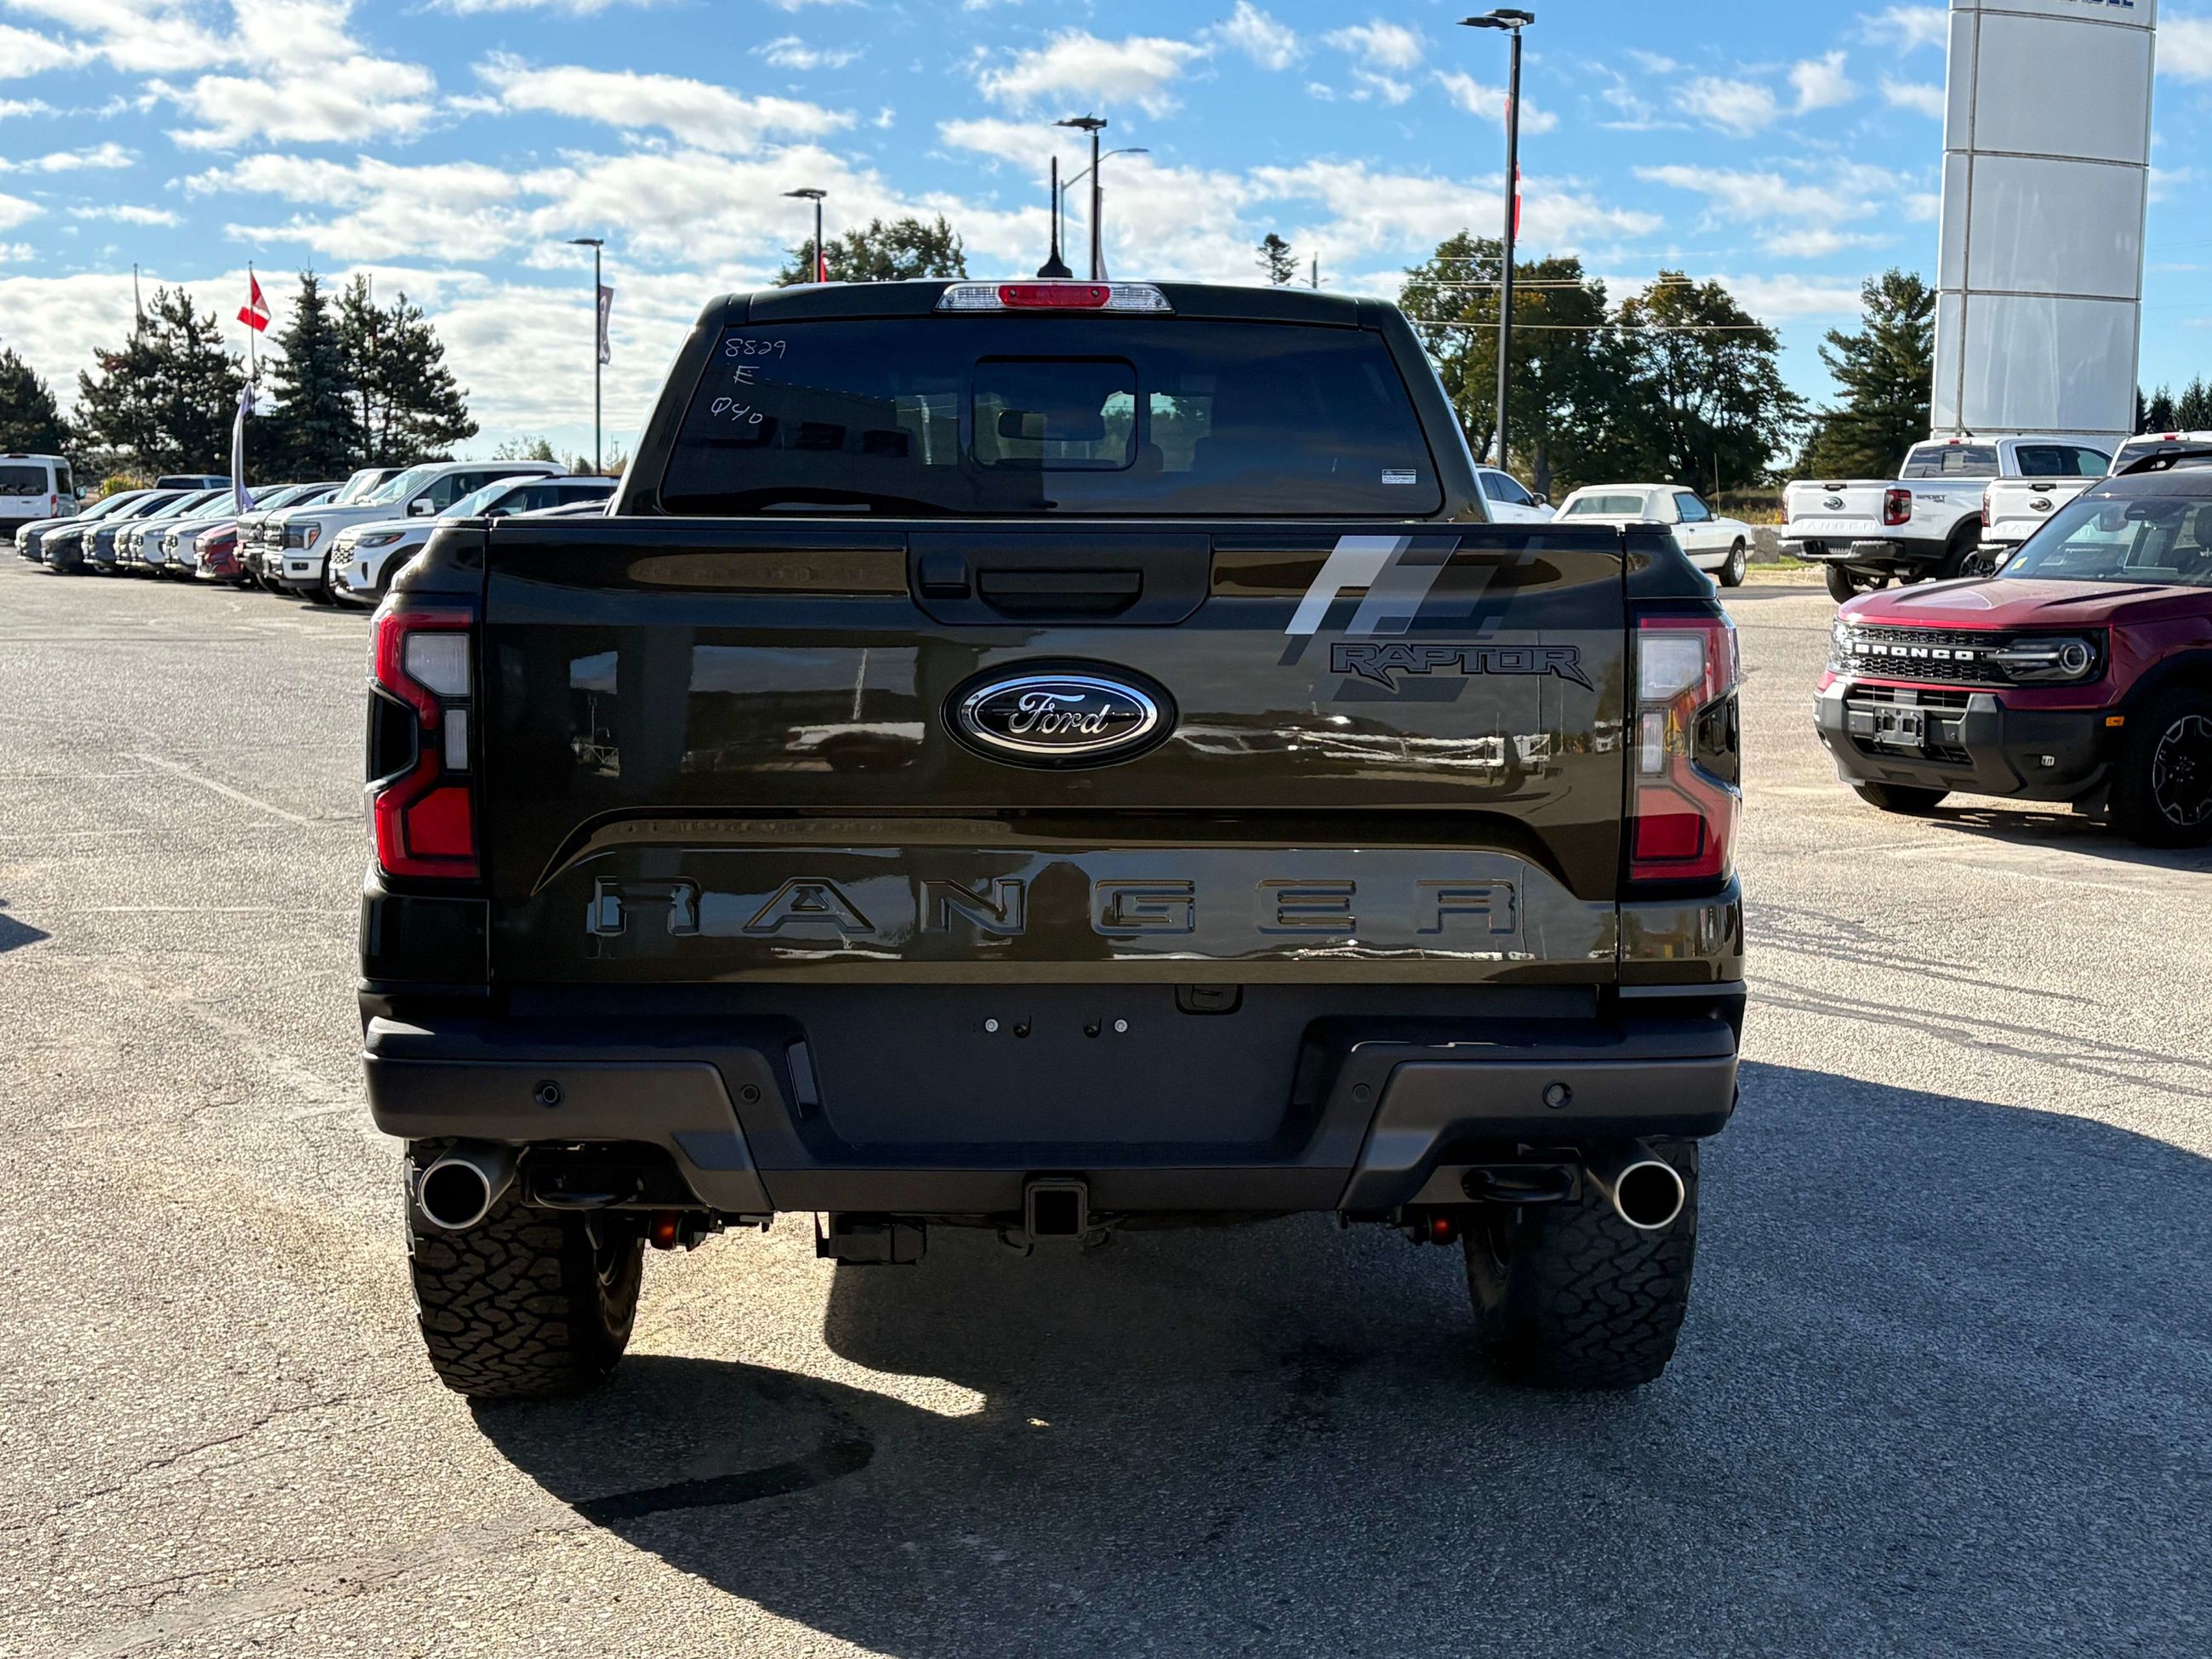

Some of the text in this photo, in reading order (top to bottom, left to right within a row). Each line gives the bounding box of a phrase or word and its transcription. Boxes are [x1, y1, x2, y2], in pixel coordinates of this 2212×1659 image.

[725, 338, 786, 360] 8829
[733, 365, 761, 385] E
[1330, 642, 1595, 693] RAPTOR
[1855, 642, 1975, 661] BRONCO
[1007, 691, 1112, 734] Ford
[594, 875, 1518, 936] RANGER
